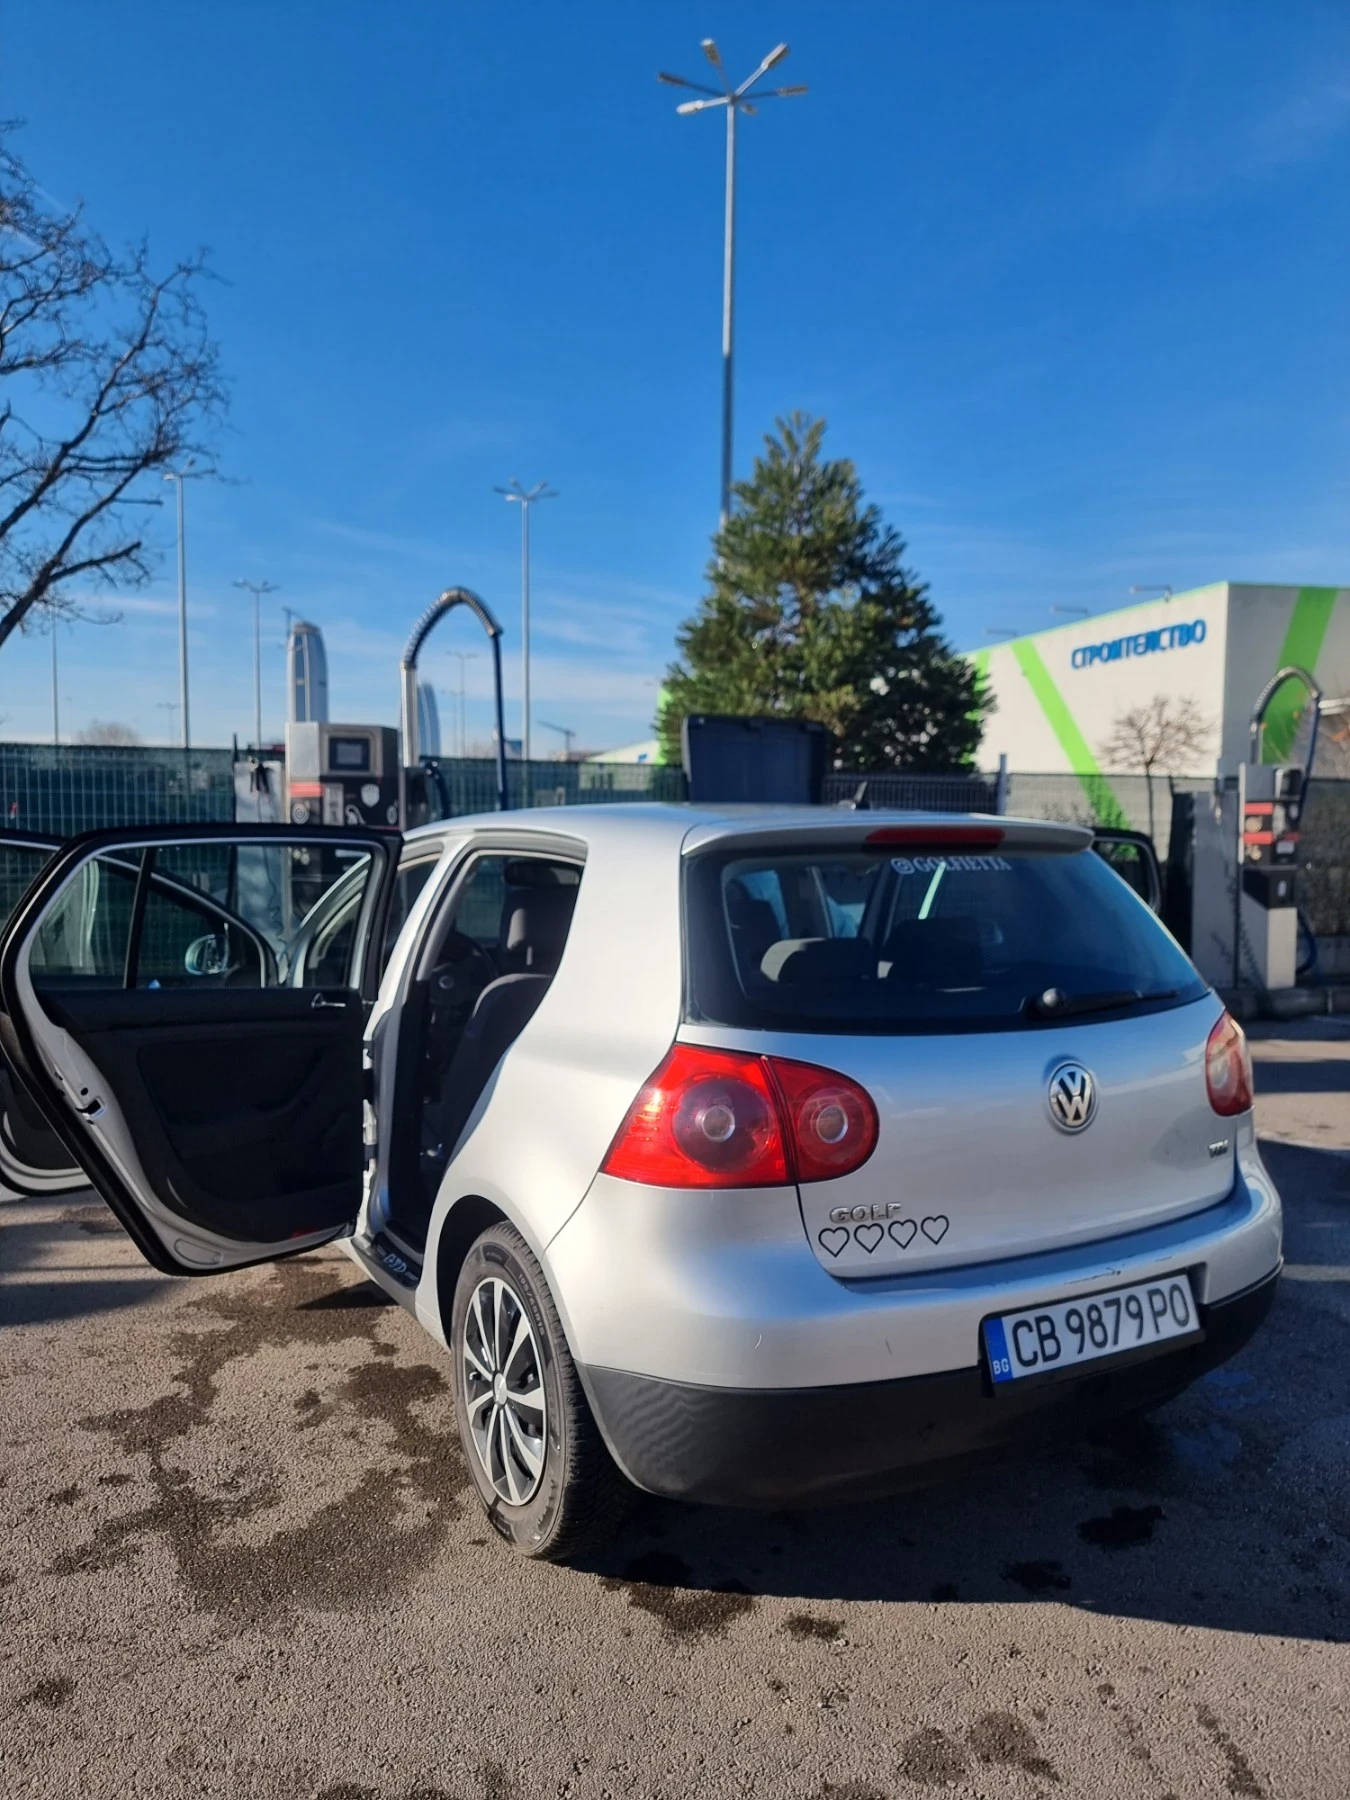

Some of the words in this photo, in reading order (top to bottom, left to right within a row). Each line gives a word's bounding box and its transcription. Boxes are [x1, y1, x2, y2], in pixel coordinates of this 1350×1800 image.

[1071, 619, 1206, 669] СТРОИТЕЛСТВО
[1049, 1059, 1094, 1128] VW
[829, 1202, 902, 1224] GOLF
[992, 1358, 1010, 1376] BG
